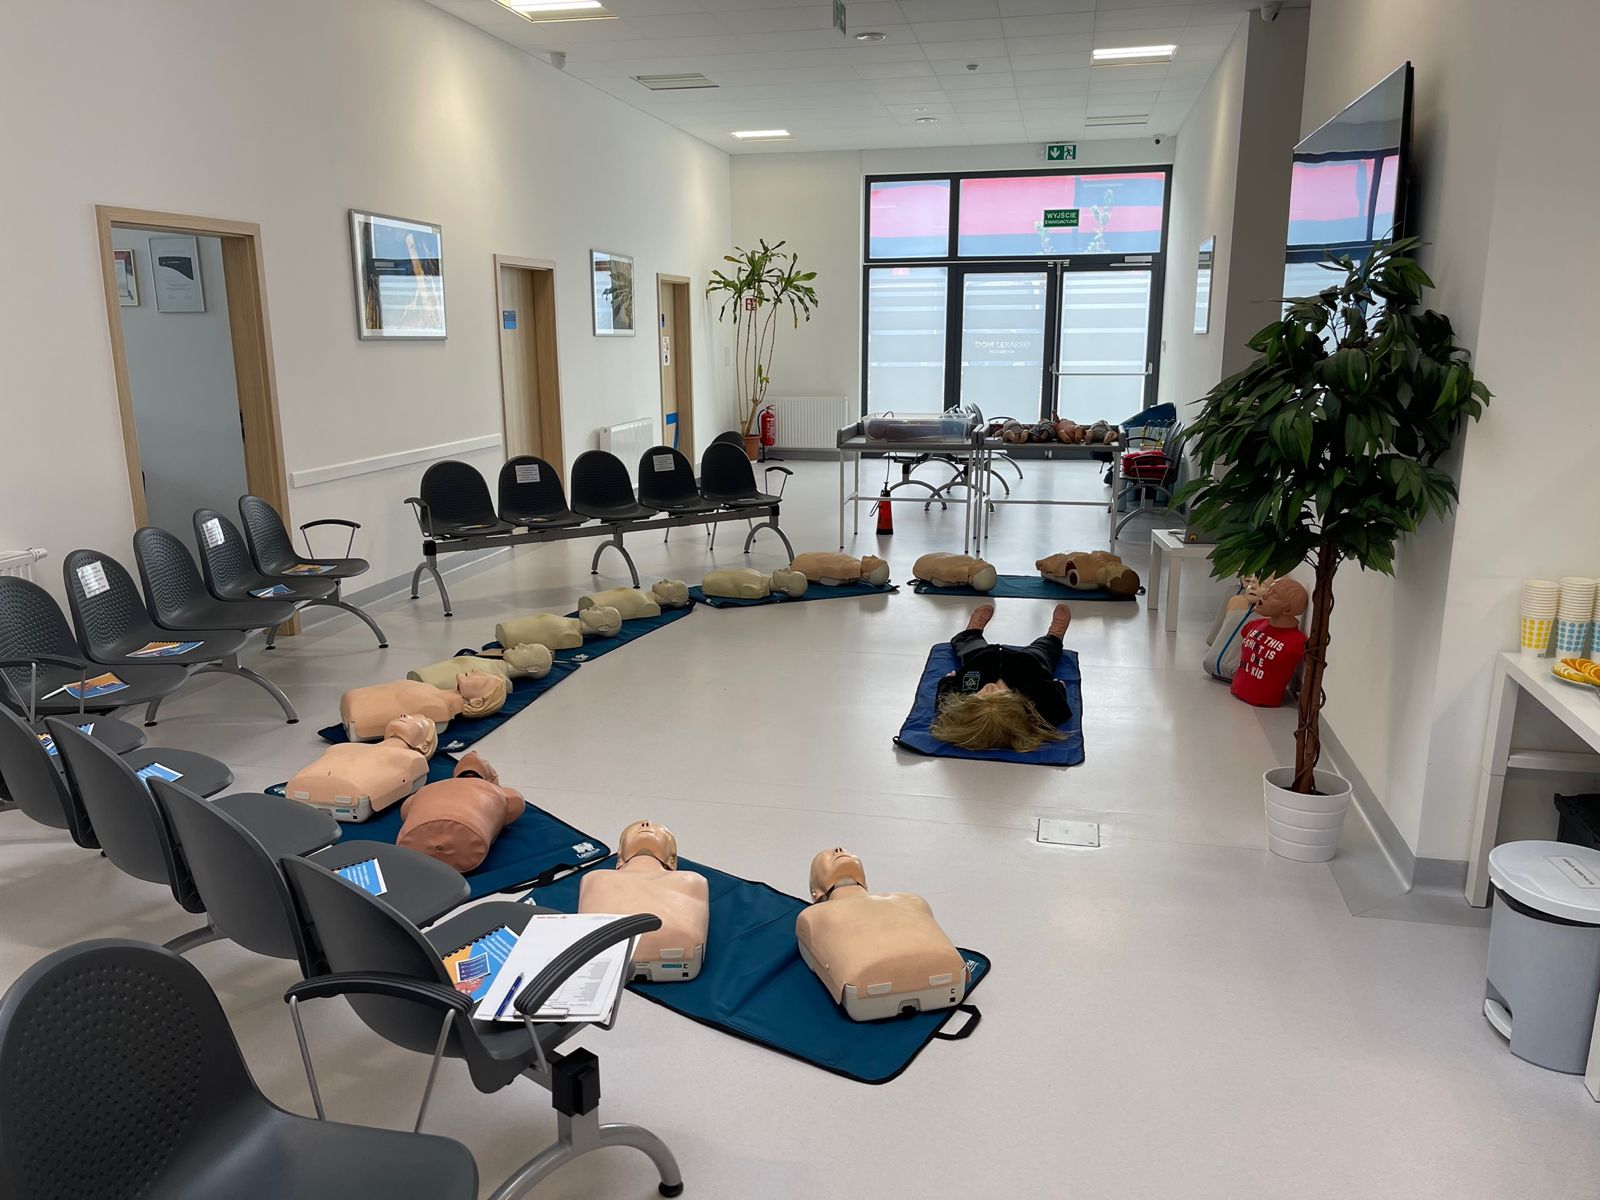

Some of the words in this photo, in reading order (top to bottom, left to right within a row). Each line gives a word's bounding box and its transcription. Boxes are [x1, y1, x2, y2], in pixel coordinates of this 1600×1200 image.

[1264, 636, 1284, 652] THIS
[1264, 650, 1276, 660] IS
[1251, 666, 1264, 680] KID
